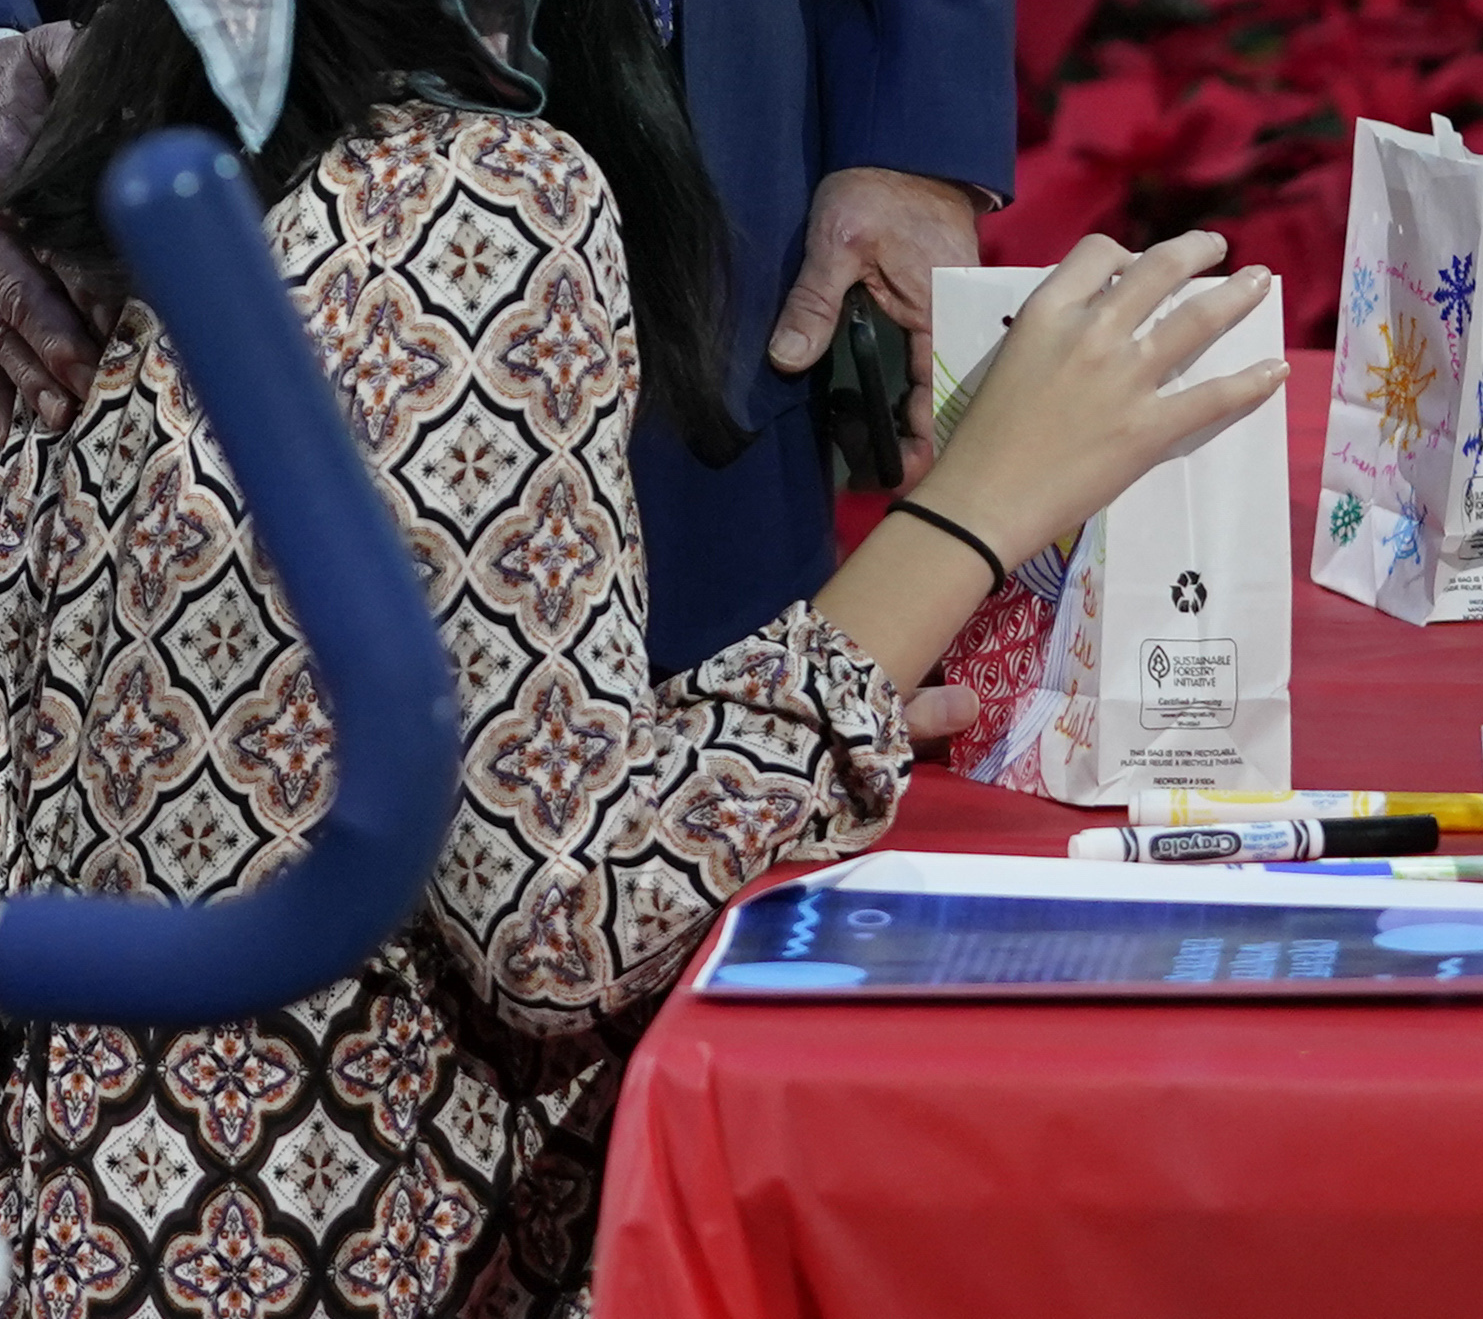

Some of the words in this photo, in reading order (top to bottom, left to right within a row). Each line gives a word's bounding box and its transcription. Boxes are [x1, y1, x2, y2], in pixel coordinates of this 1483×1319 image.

[1172, 654, 1232, 666] SUSTAINABLE
[1173, 666, 1216, 677] FORESTRY
[1173, 676, 1216, 688] INITIATIVE
[1147, 749, 1164, 757] BAG
[1181, 758, 1214, 766] RECYCLE
[1153, 777, 1188, 785] REORDER
[1158, 832, 1236, 857] Crayola
